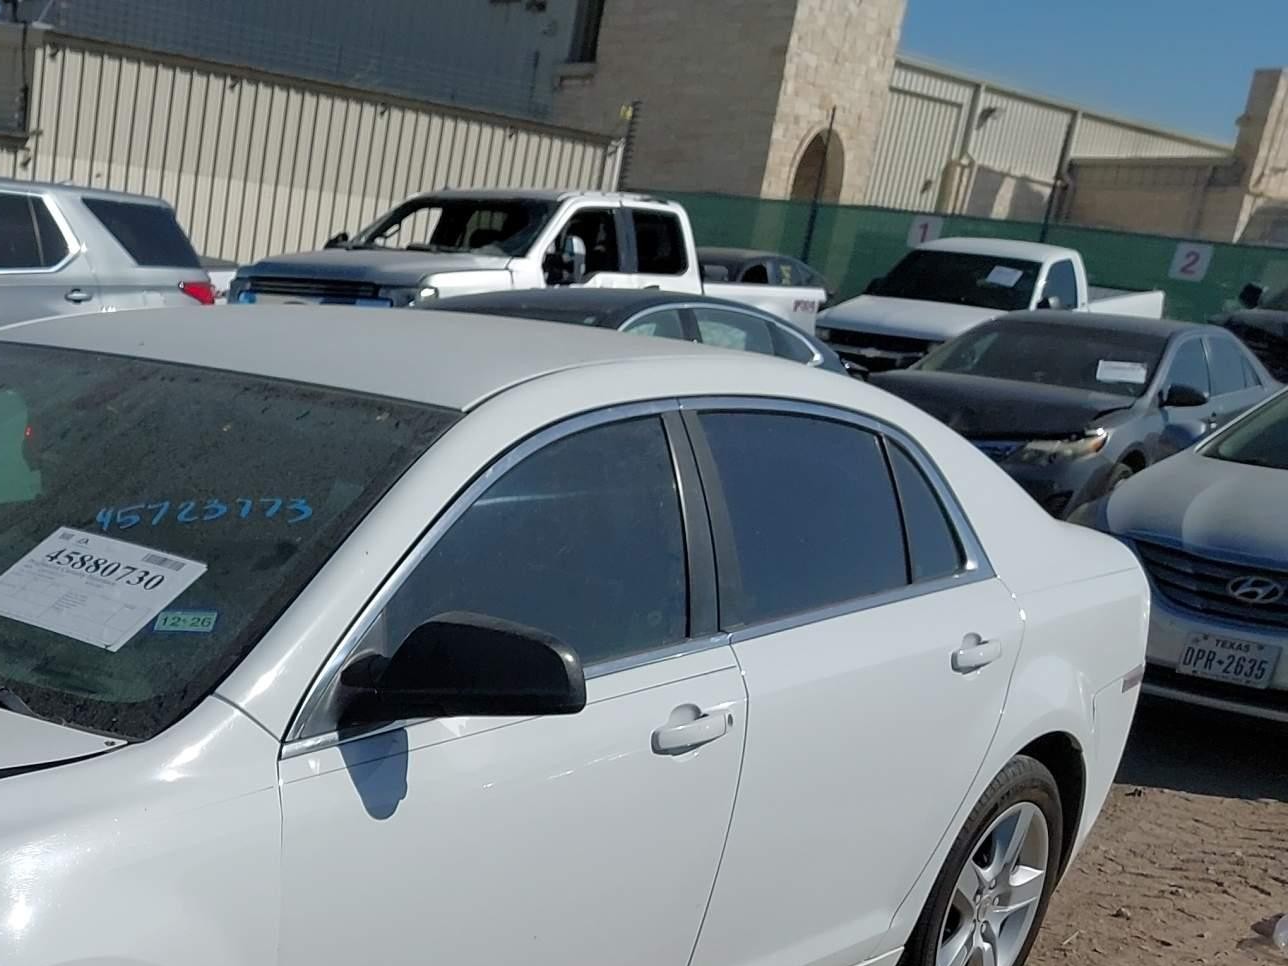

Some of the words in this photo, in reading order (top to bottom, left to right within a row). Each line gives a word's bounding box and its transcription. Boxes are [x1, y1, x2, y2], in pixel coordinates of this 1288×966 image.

[919, 222, 929, 243] 1
[1179, 250, 1201, 275] 2
[45, 548, 165, 591] 45880730
[1215, 638, 1251, 653] TEXAS
